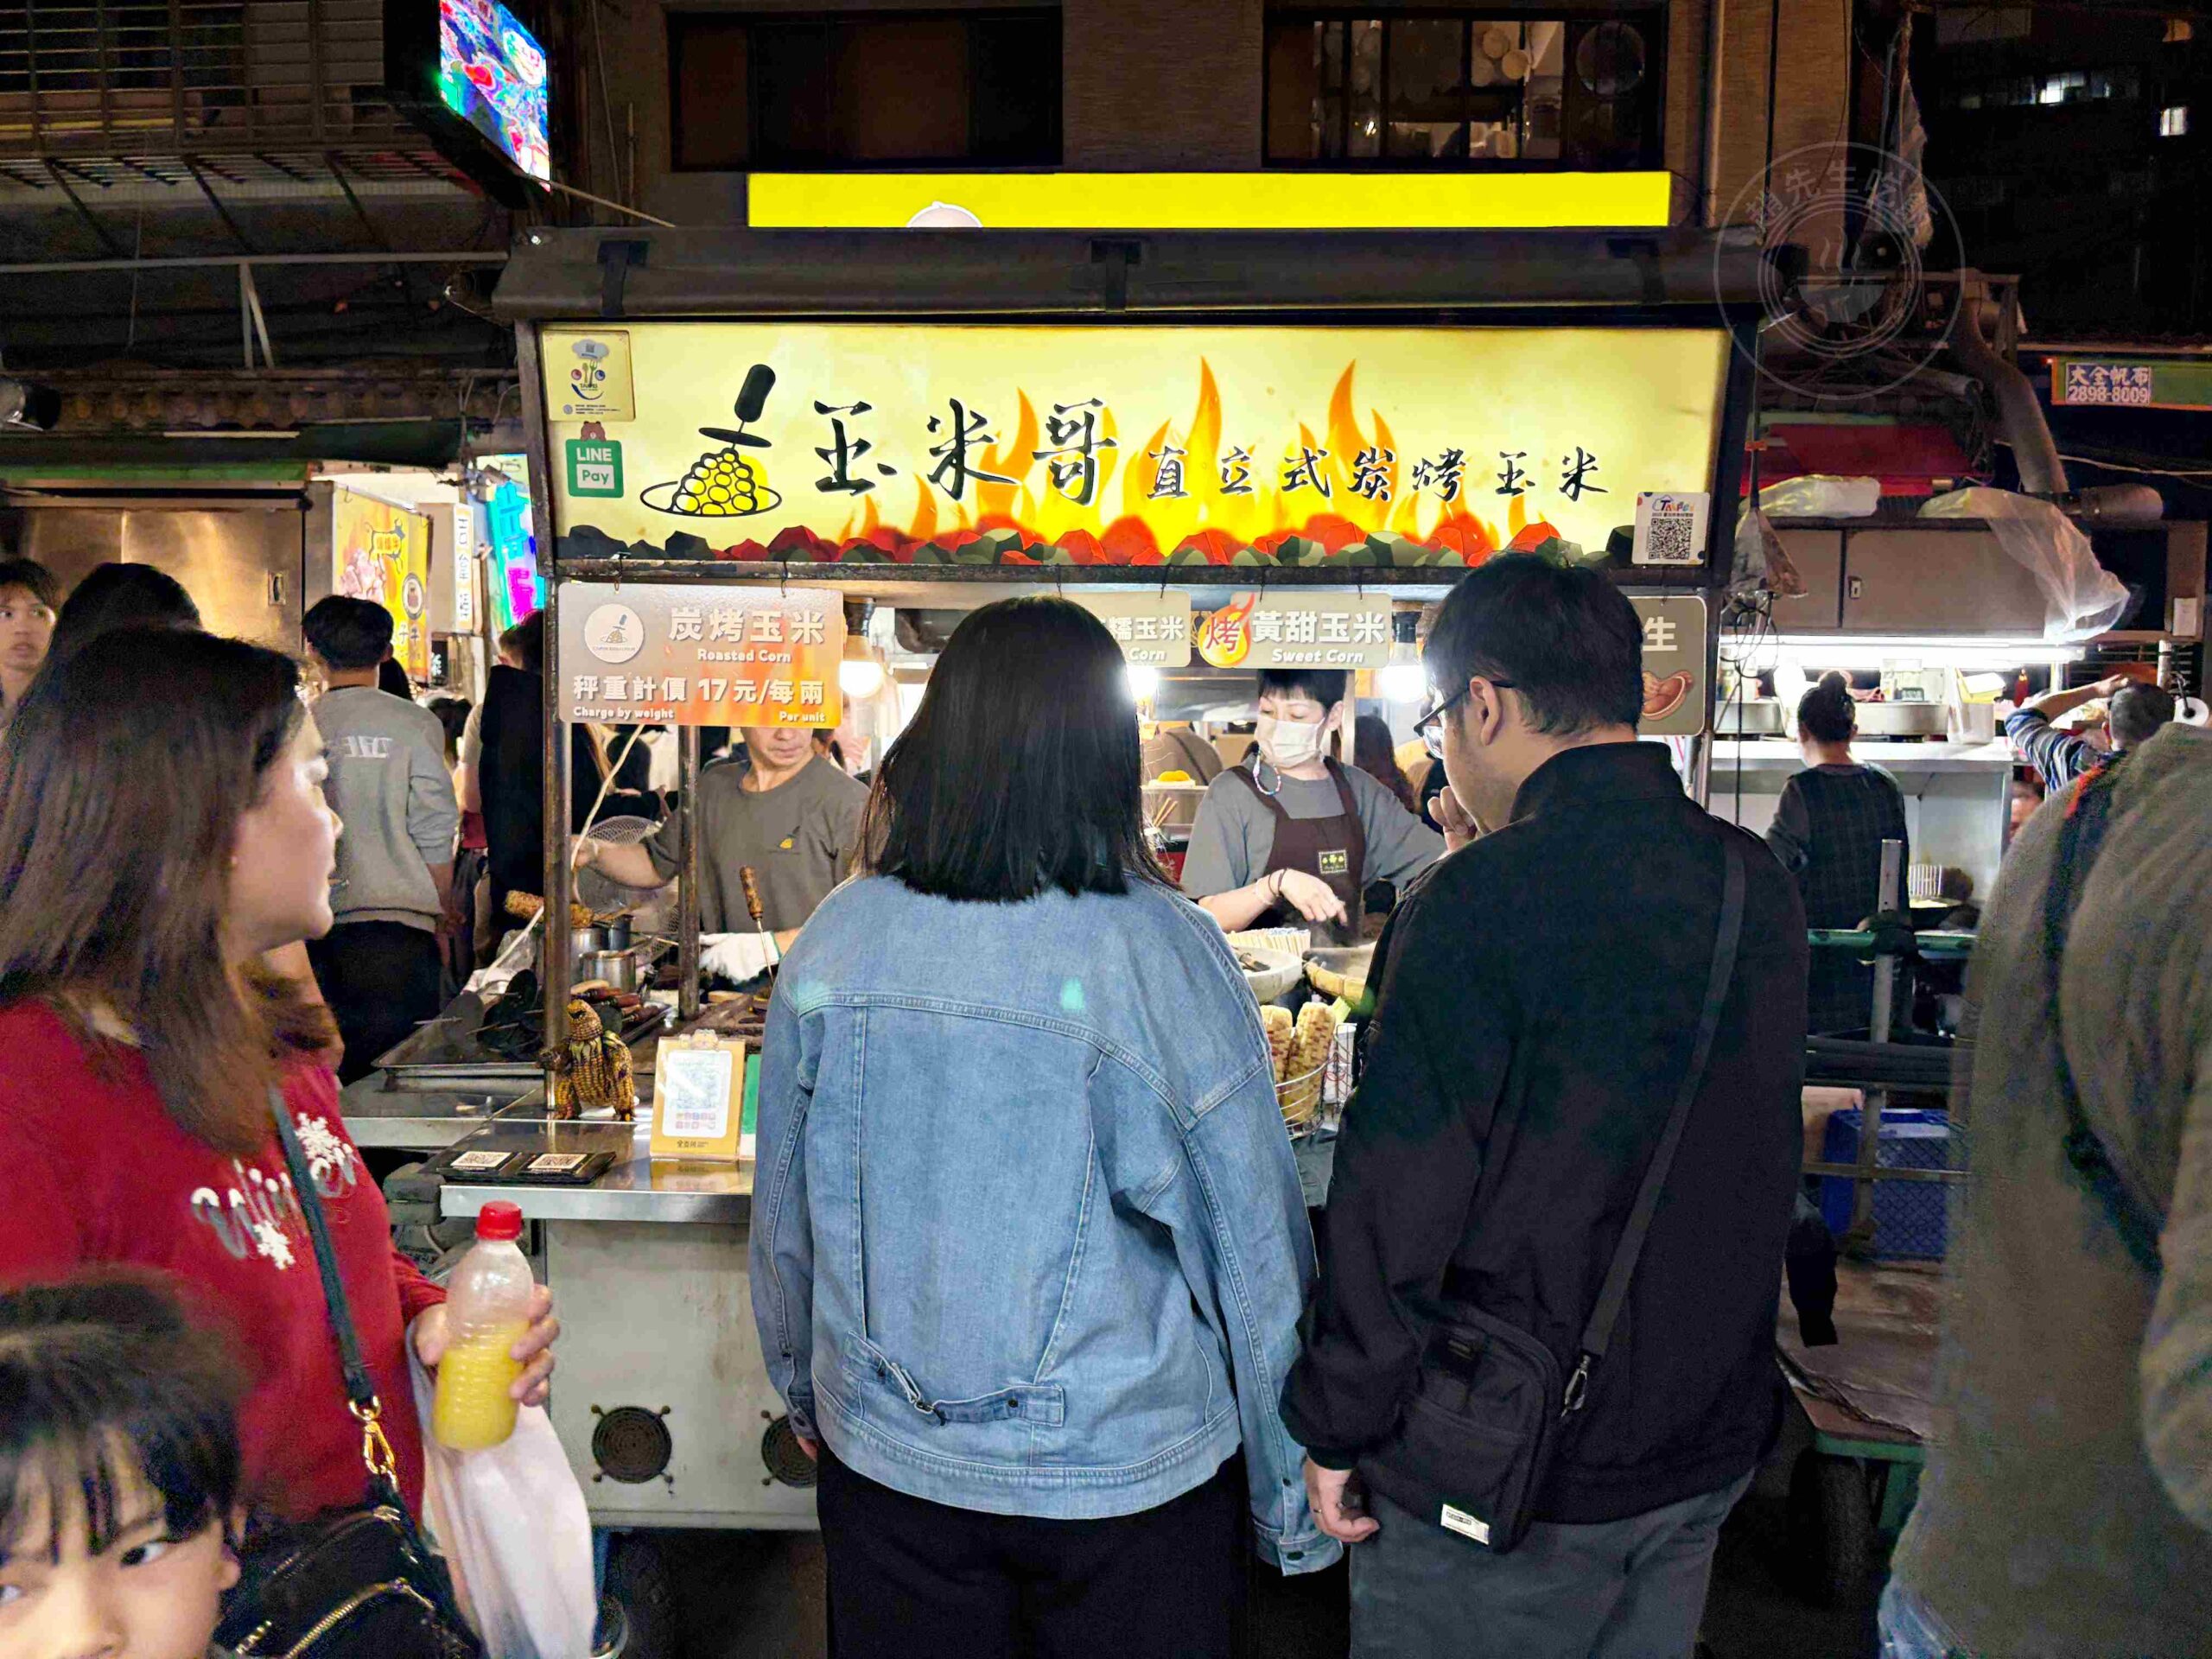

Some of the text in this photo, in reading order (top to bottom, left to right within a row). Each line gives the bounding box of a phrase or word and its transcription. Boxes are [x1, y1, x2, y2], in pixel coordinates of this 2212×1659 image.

[2069, 385, 2150, 403] 2898-8009
[576, 447, 613, 462] LINE
[813, 397, 1609, 507] 玉米哥 直立式炭烤玉米
[582, 469, 610, 485] Pay
[668, 607, 825, 645] 炭烤玉米
[1101, 615, 1185, 641] 糯玉米
[1205, 616, 1241, 652] 烤
[1251, 610, 1386, 645] 黃甜玉米
[1643, 616, 1678, 652] 生
[697, 648, 792, 664] Roasted Corn
[1128, 647, 1166, 661] Corn
[1272, 648, 1364, 664] Sweet Corn
[573, 674, 688, 702] 秤重計價
[573, 706, 675, 721] Charge by weight
[779, 711, 826, 722] Per unit
